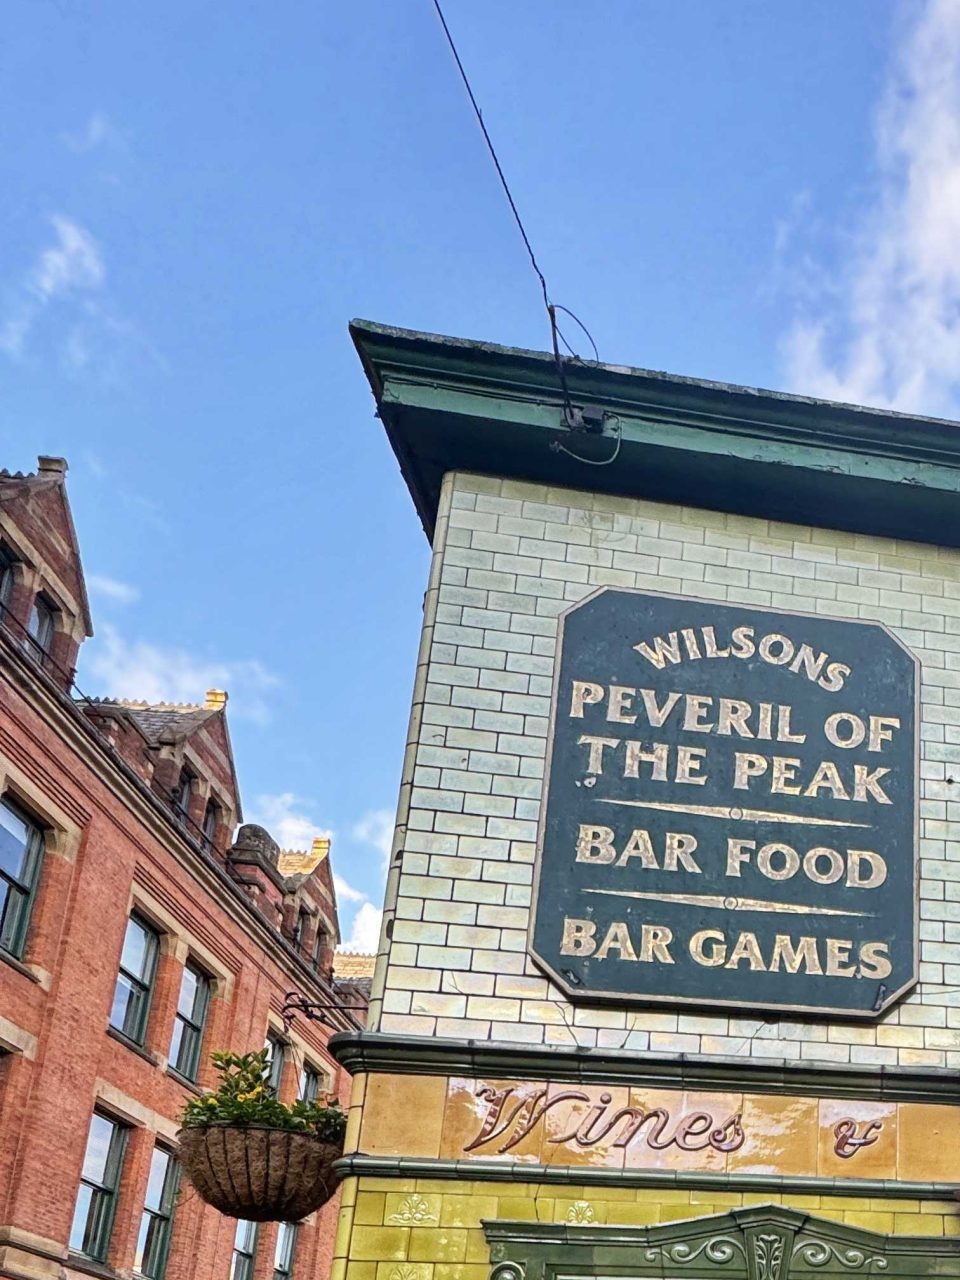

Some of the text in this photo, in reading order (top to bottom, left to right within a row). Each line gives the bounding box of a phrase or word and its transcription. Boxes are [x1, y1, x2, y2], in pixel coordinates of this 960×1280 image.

[634, 626, 851, 692] WILSONS
[569, 681, 901, 752] PEVERIL OF
[577, 734, 893, 805] THE PEAK
[575, 824, 888, 890] BAR FOOD
[559, 918, 893, 980] BAR GAMES
[463, 1086, 745, 1154] Wines
